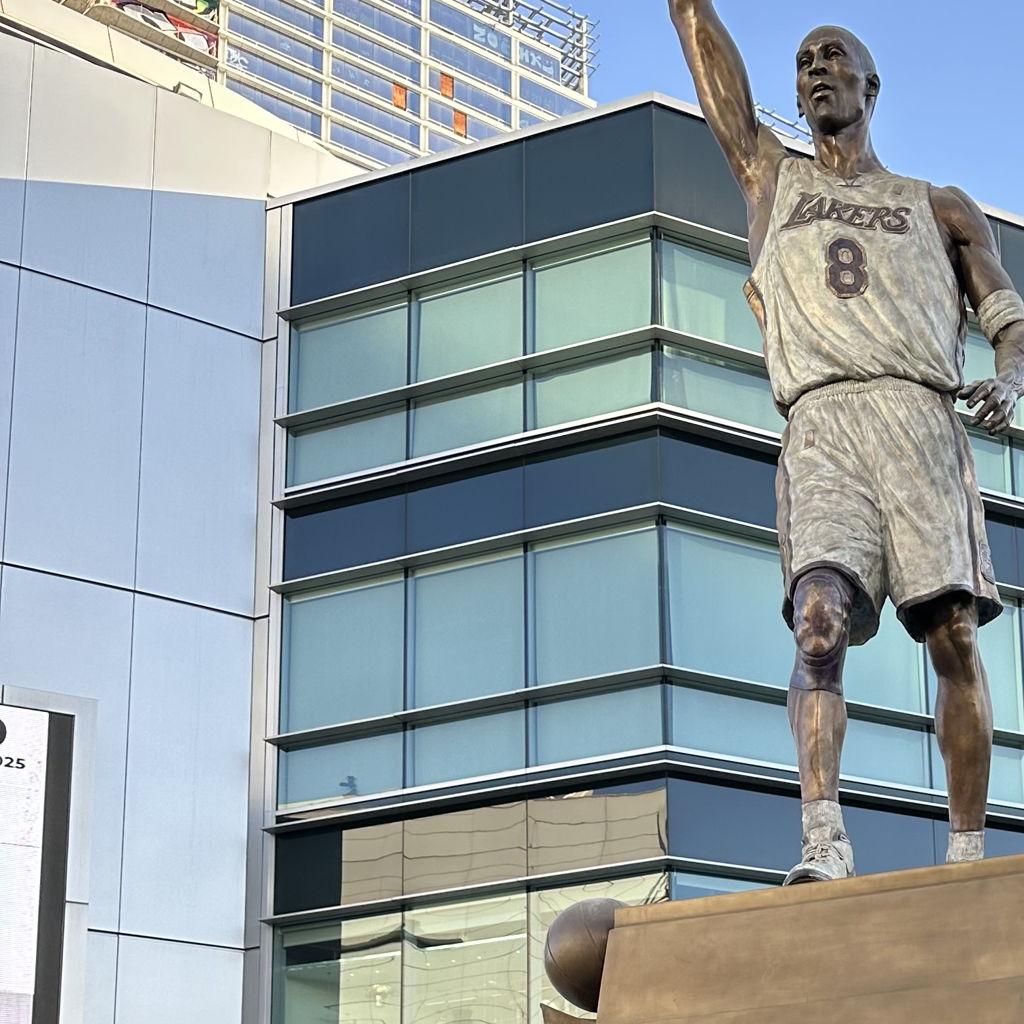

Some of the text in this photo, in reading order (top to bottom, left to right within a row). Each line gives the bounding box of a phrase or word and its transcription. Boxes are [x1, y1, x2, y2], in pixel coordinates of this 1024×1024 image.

[780, 191, 912, 234] LAKERS
[824, 238, 869, 299] 8
[0, 755, 26, 770] 25
